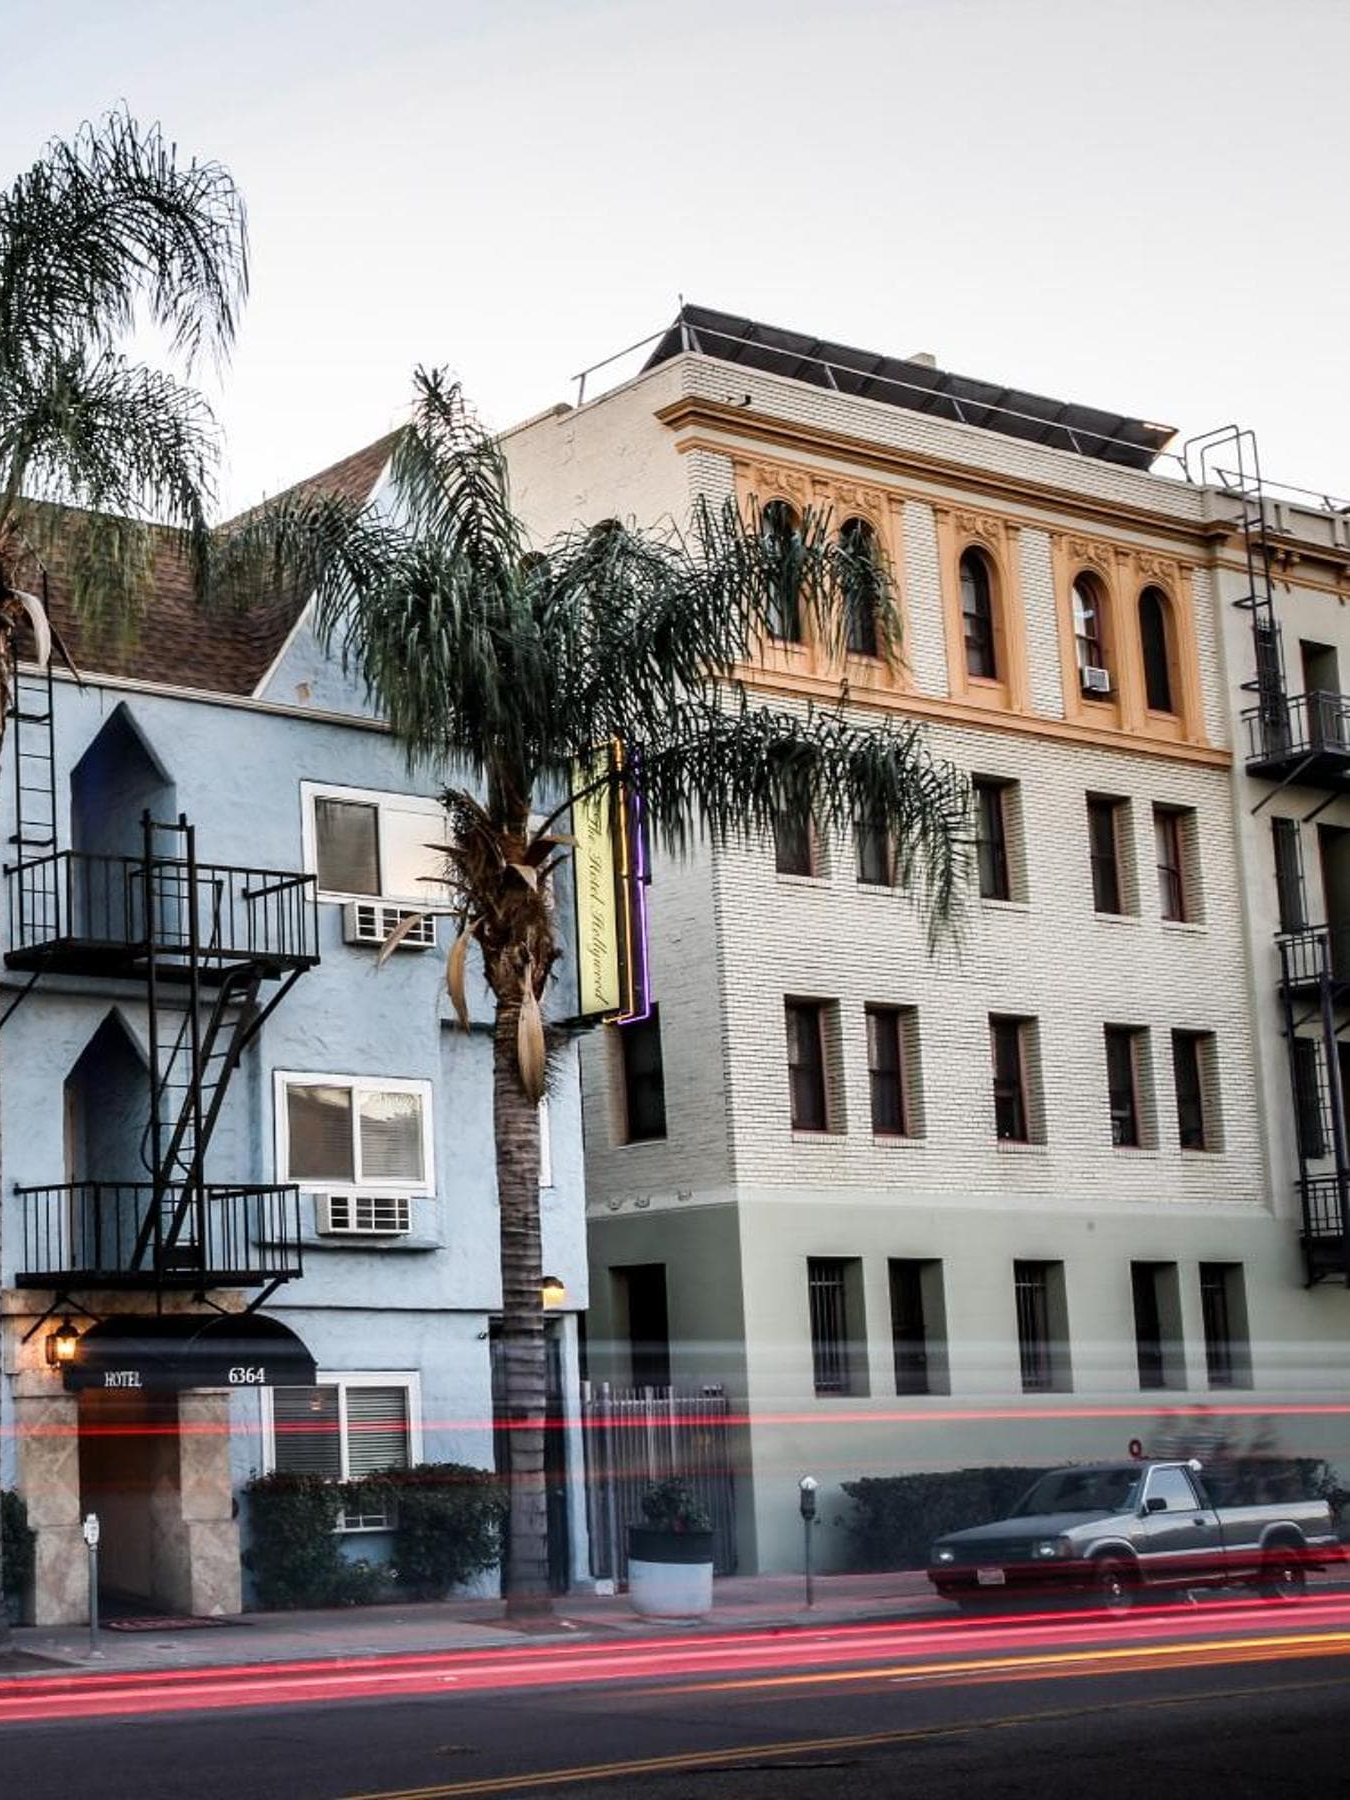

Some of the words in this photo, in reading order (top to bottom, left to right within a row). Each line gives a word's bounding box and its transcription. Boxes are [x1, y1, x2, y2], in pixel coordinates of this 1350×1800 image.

[587, 814, 602, 841] The
[588, 850, 606, 906] Hotel
[587, 910, 609, 1006] Hollywood
[103, 1371, 143, 1387] HOTEL
[228, 1367, 267, 1383] 6364
